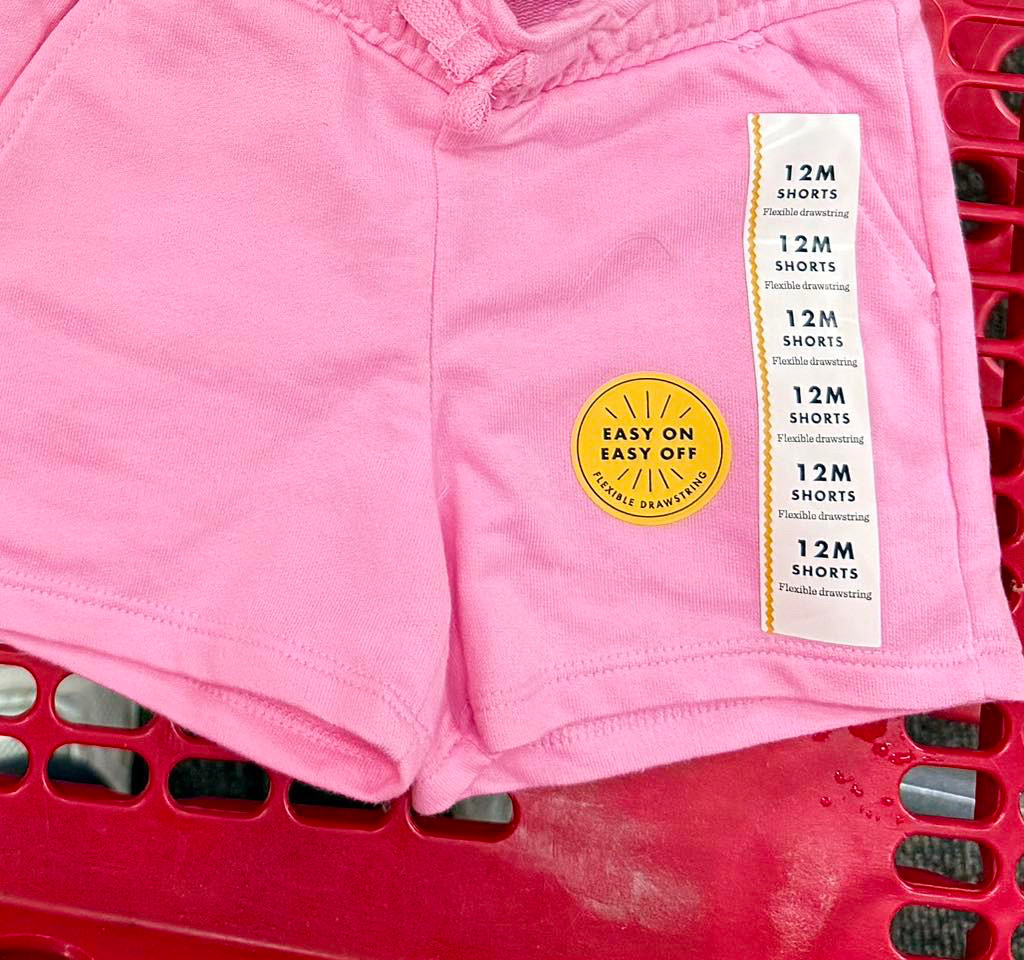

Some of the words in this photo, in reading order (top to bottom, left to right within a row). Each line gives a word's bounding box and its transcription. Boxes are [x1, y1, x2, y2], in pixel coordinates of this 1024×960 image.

[785, 164, 835, 181] 12M
[777, 188, 837, 199] SHORTS
[763, 208, 798, 216] Flexible
[800, 208, 849, 218] drawstring
[780, 235, 832, 253] 12M
[775, 260, 836, 272] SHORTS
[765, 281, 800, 290] Flexible
[802, 282, 850, 292] drawstring
[786, 309, 838, 328] 12M
[783, 335, 843, 347] SHORTS
[772, 356, 808, 365] Flexible
[810, 357, 858, 368] drawstring
[793, 386, 845, 404] 12M
[790, 412, 850, 424] SHORTS
[603, 427, 653, 440] EASY
[662, 427, 693, 440] ON
[777, 434, 814, 443] Flexible
[816, 434, 864, 445] drawstring
[601, 447, 651, 460] EASY
[660, 447, 697, 460] OFF
[797, 463, 851, 482] 12M
[592, 470, 635, 507] FLEXIBLE
[640, 470, 708, 509] DRAWSTRING
[791, 489, 855, 502] SHORTS
[778, 509, 816, 520] Flexible
[818, 511, 870, 523] drawstring
[798, 539, 855, 560] 12M
[792, 564, 858, 579] SHORTS
[779, 582, 817, 595] Flexible
[819, 587, 872, 601] drawstring
